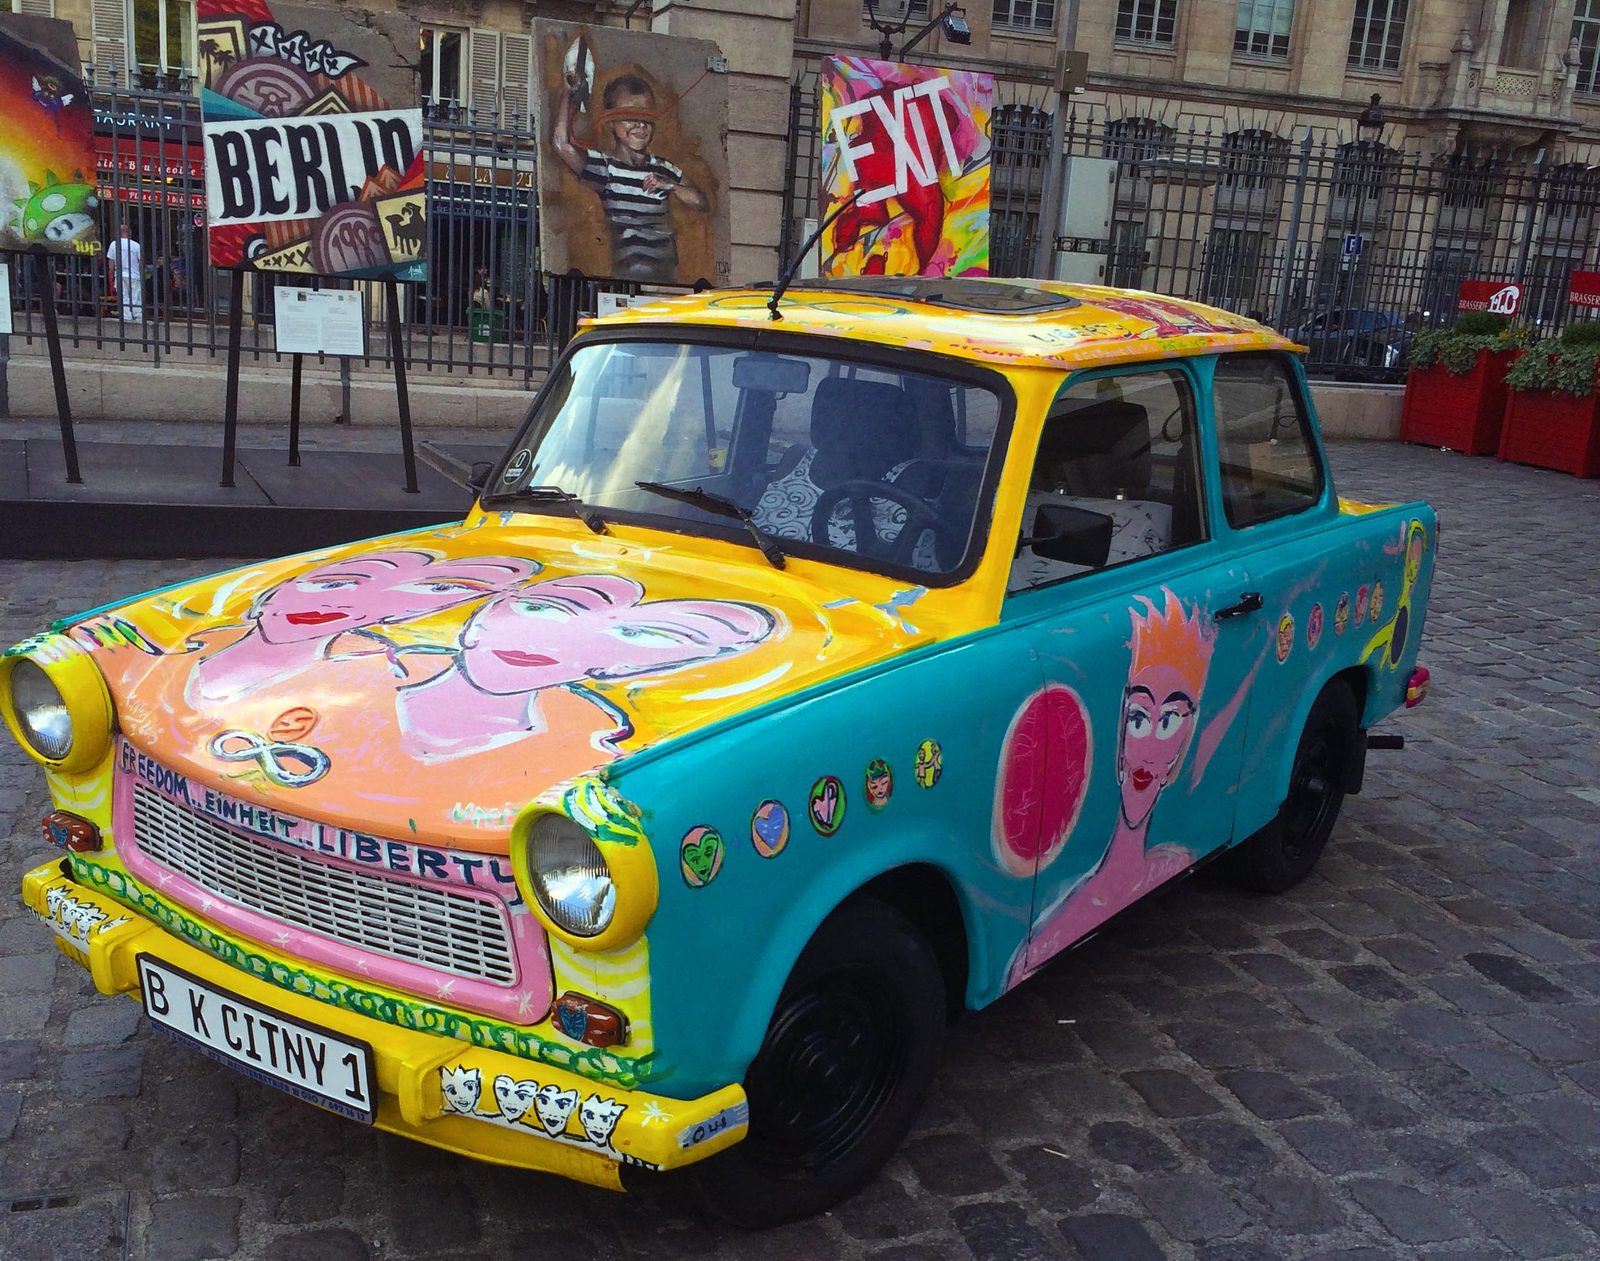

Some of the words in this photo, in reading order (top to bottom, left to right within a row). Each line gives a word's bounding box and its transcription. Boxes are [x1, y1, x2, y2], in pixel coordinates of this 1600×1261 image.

[207, 117, 416, 219] BERLIN
[830, 75, 962, 207] EXIT
[1487, 285, 1520, 315] FLO
[317, 824, 524, 907] LIBERTY
[146, 967, 170, 1016] B
[342, 1053, 366, 1102] 1
